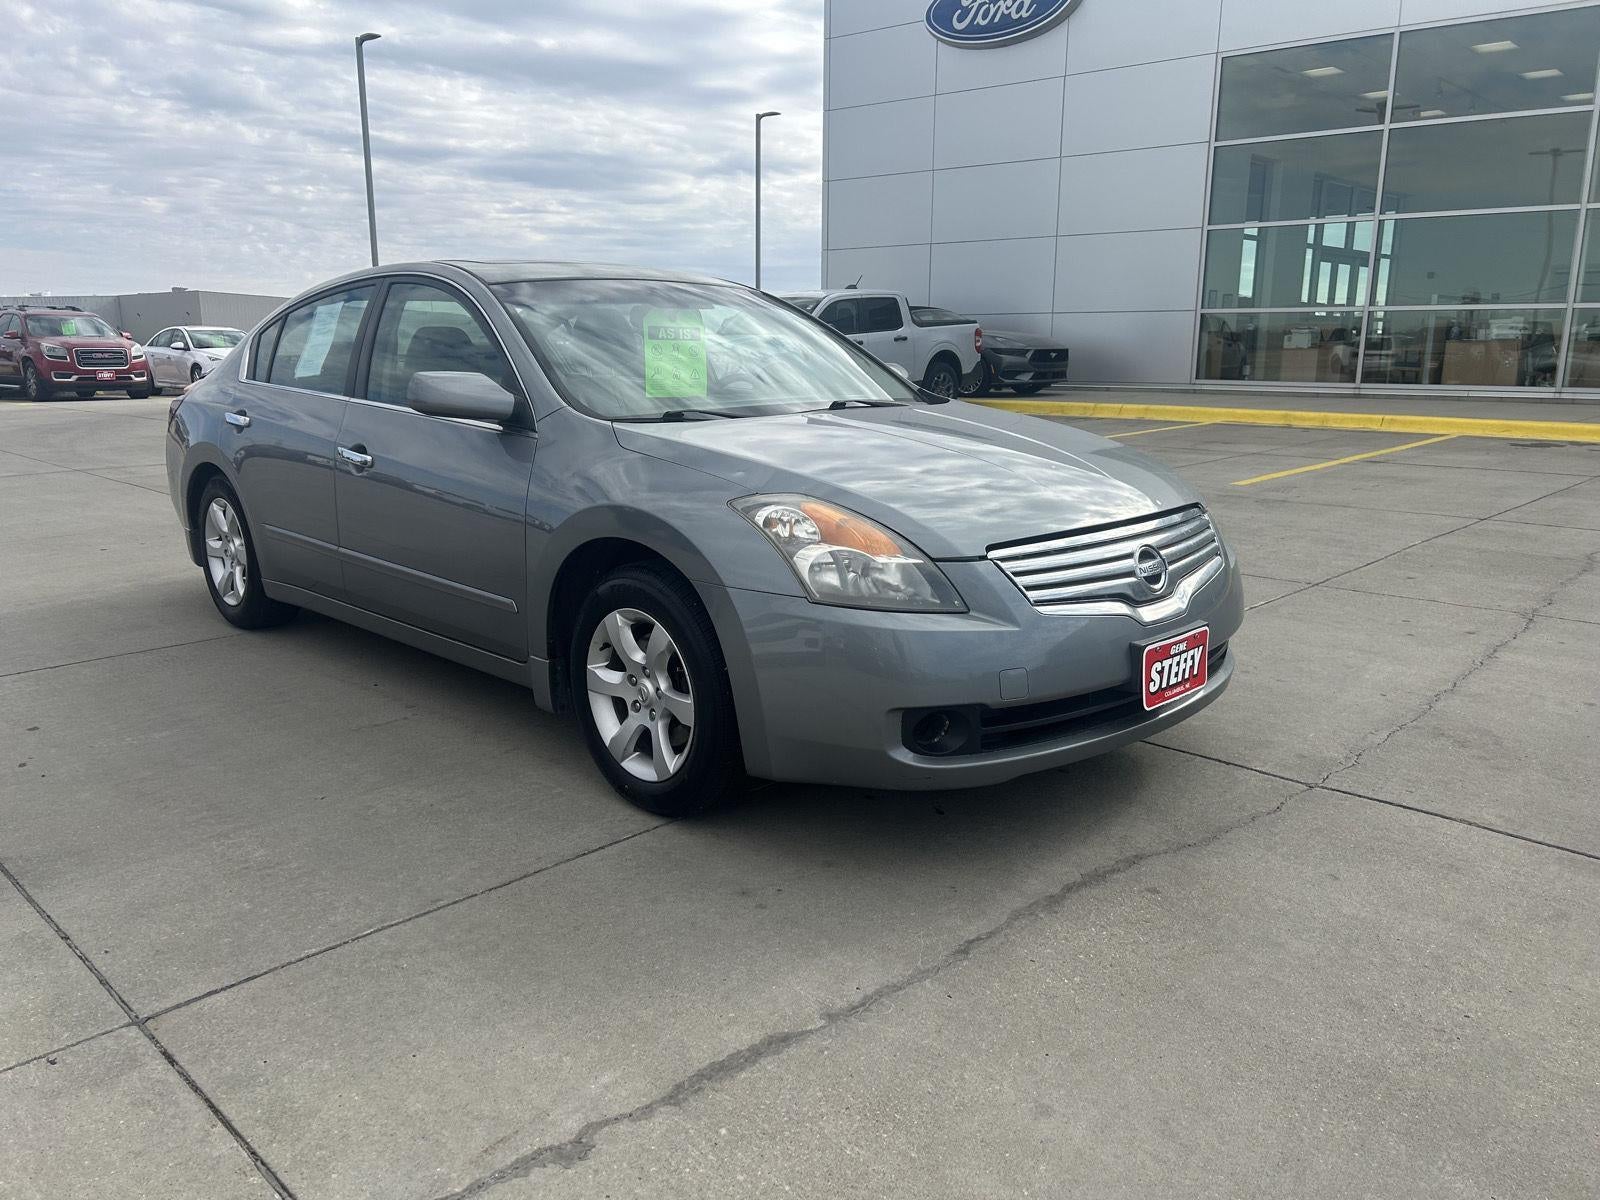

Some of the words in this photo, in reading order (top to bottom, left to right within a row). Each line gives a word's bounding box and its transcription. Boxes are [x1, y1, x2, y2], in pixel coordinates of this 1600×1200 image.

[952, 0, 1037, 30] Ford
[658, 328, 675, 339] AS
[679, 328, 690, 339] IS
[1139, 562, 1162, 574] NISS
[1170, 640, 1188, 655] GENE
[1149, 646, 1204, 693] STEFFY
